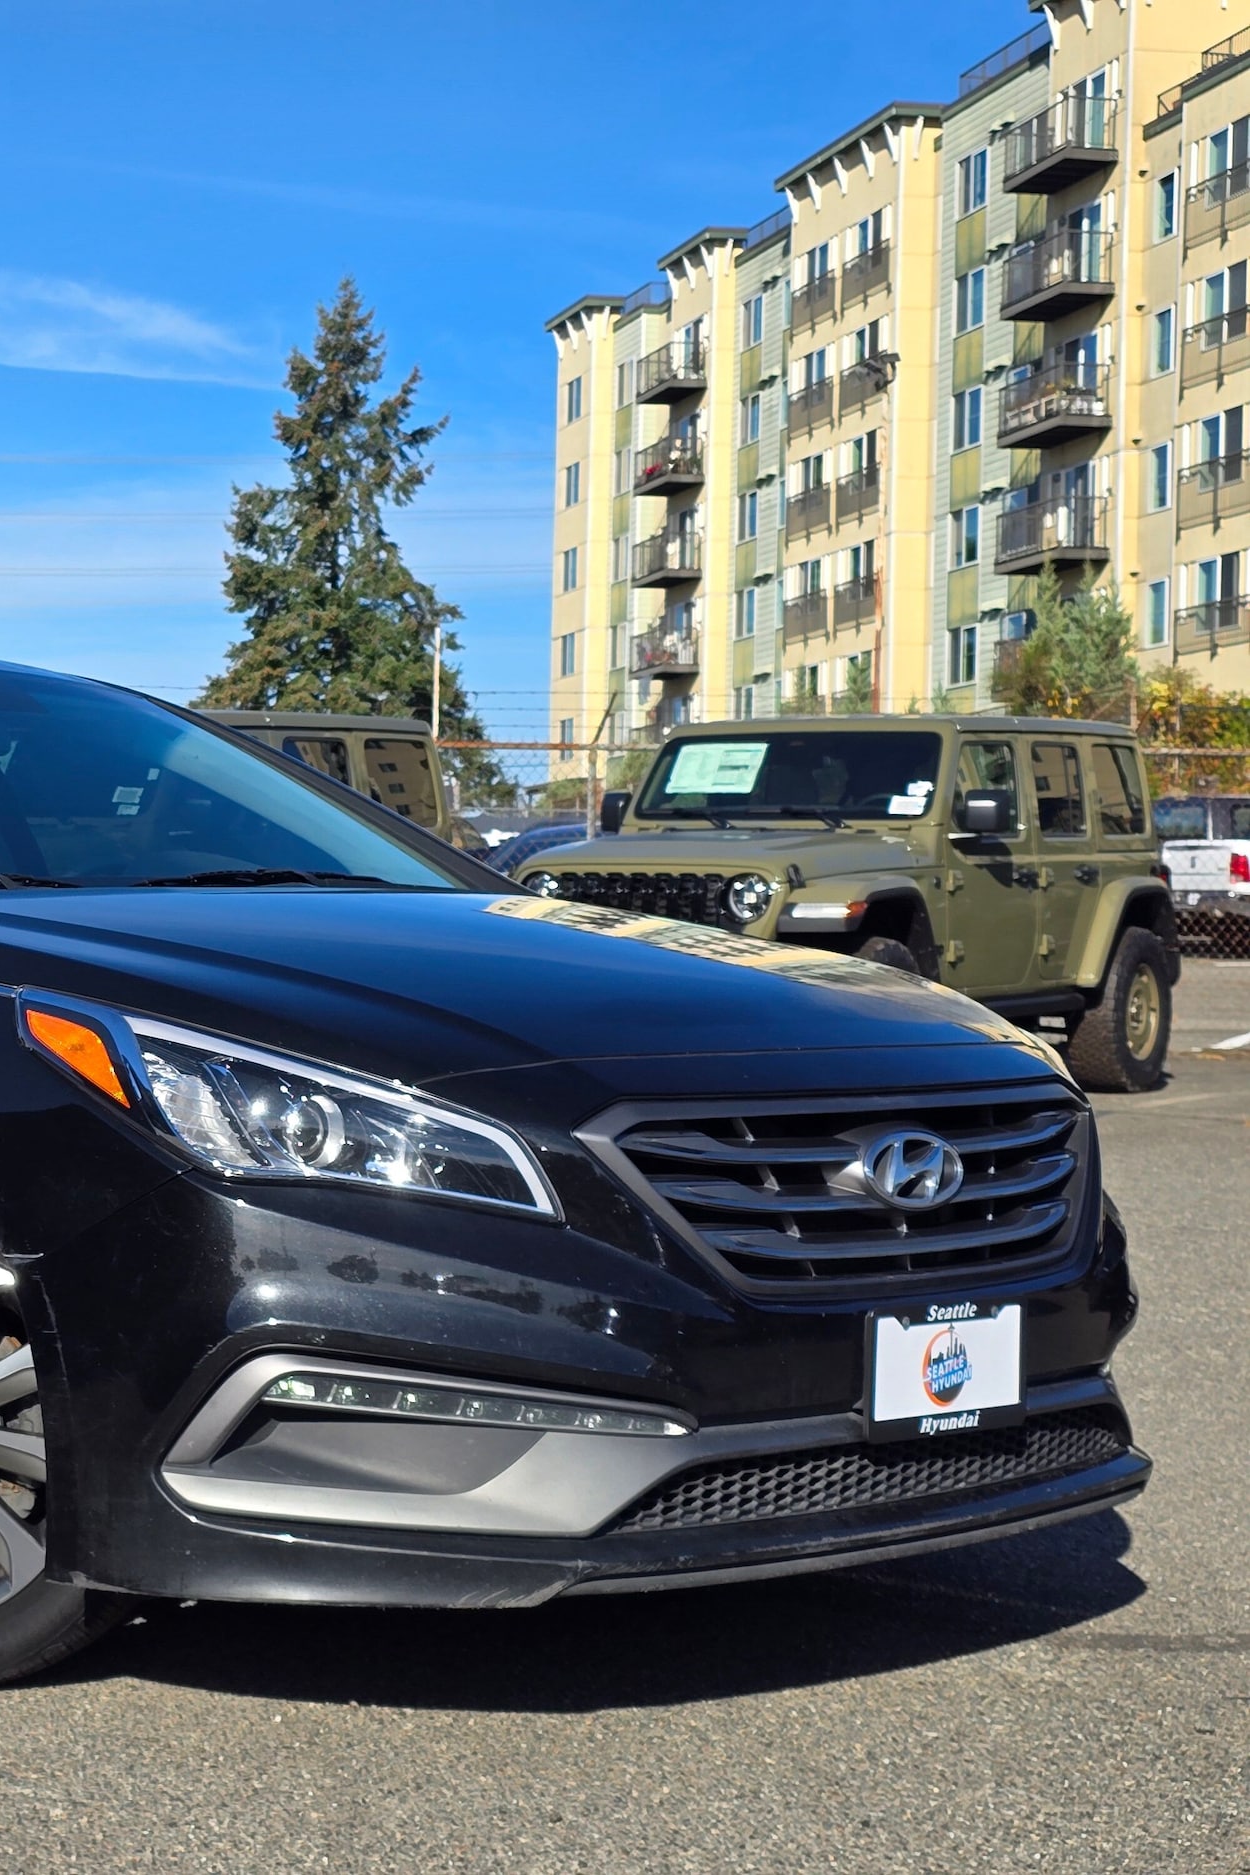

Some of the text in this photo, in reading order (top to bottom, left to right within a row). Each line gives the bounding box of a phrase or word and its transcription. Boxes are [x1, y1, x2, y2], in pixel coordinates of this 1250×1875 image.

[927, 1302, 978, 1322] Seattle
[925, 1354, 966, 1381] SEATTLE
[931, 1365, 973, 1394] HYUNDAI
[919, 1410, 981, 1436] Hyundai
